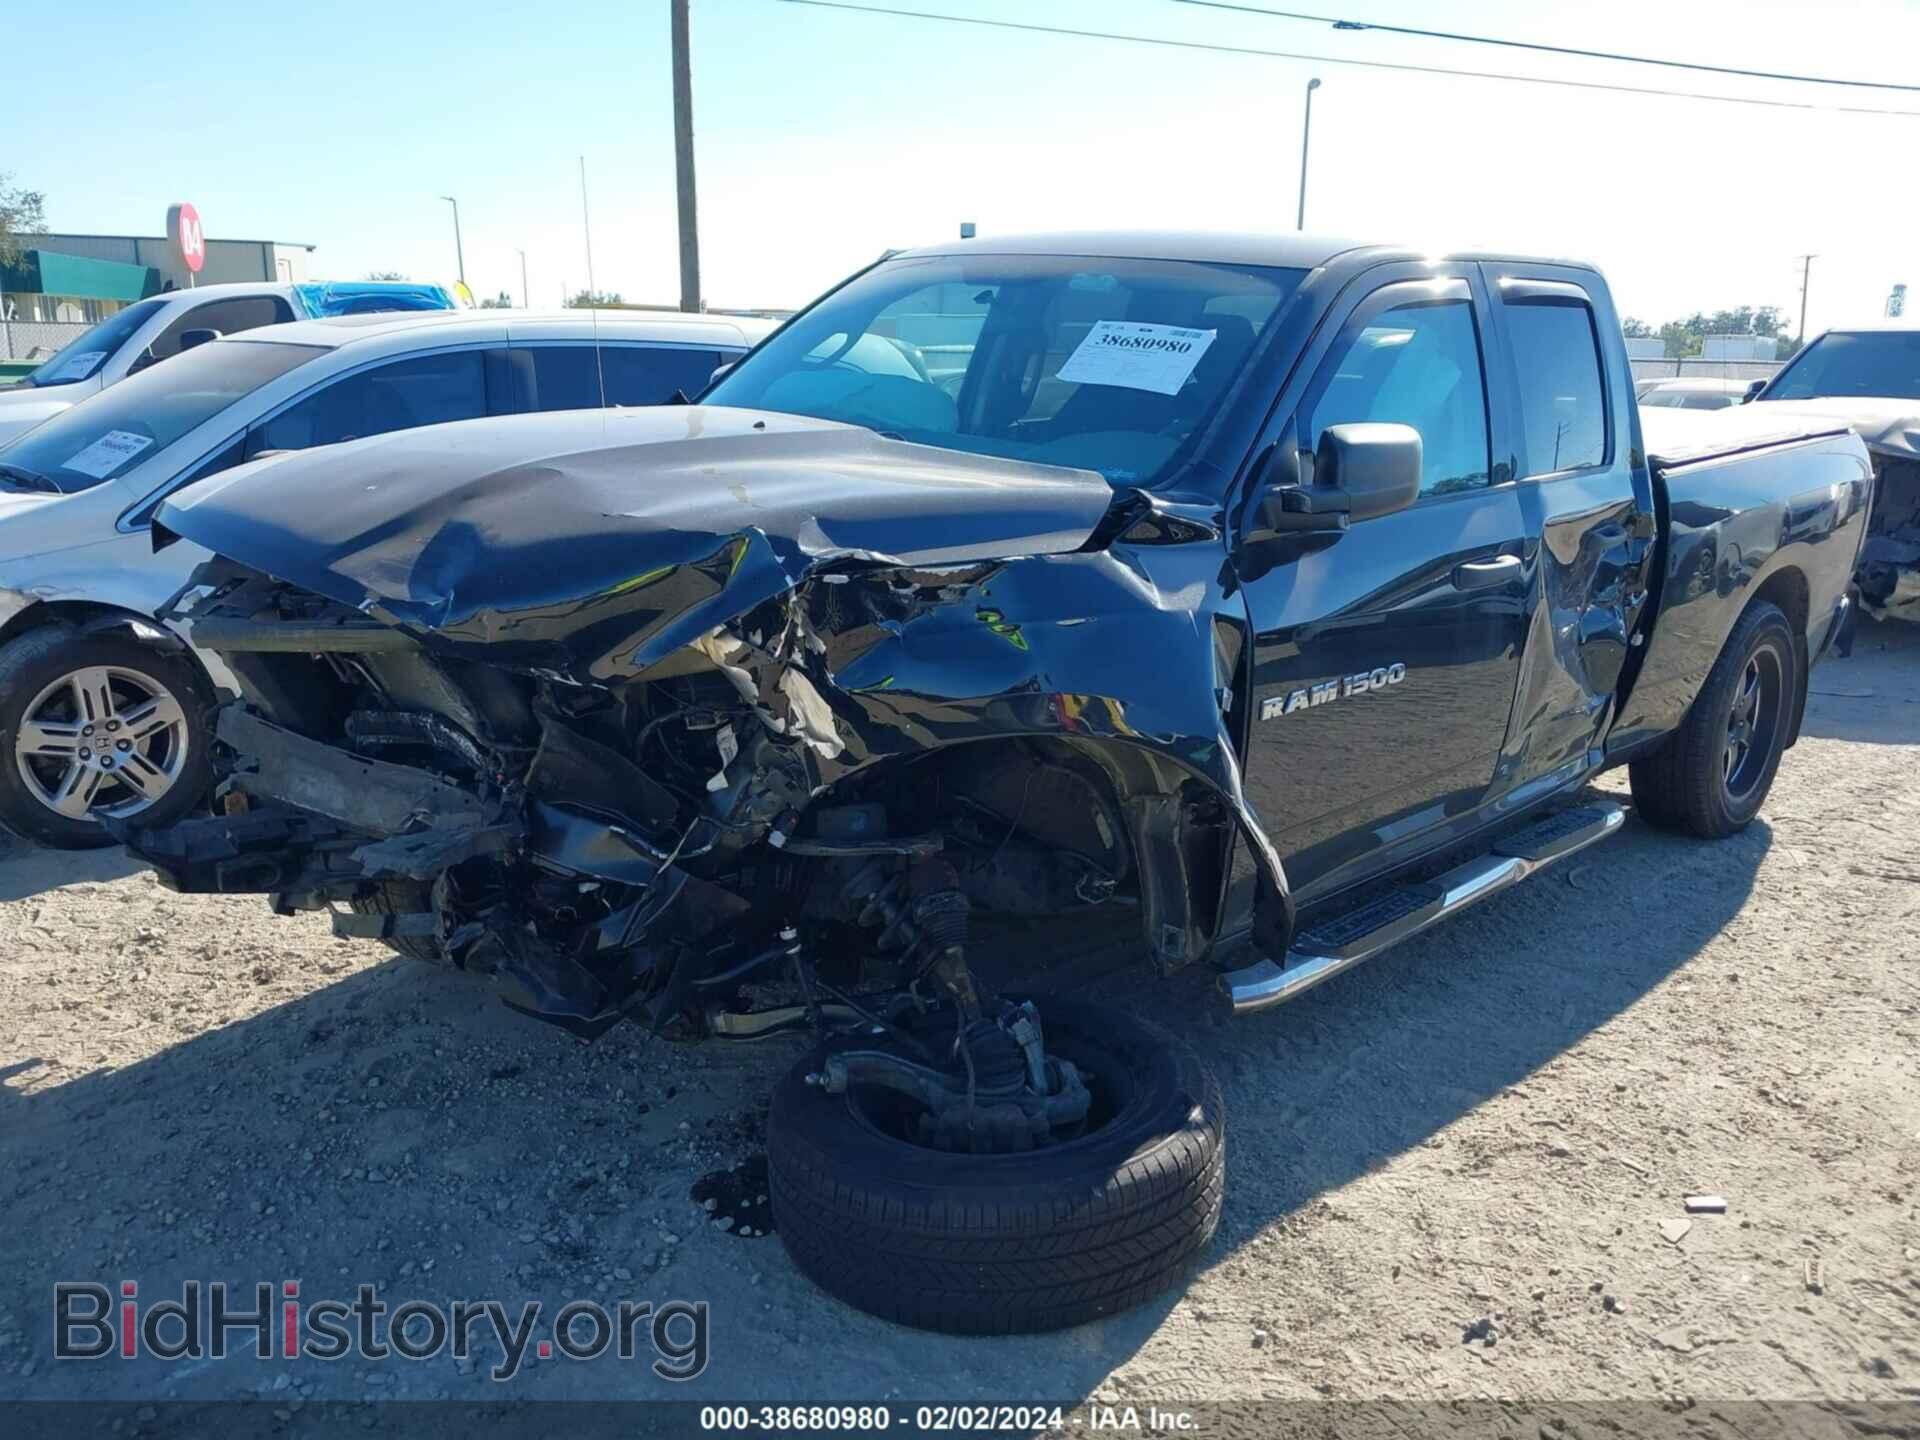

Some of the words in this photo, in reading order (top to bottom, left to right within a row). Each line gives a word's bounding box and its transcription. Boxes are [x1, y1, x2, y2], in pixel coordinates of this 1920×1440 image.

[1095, 333, 1192, 353] 38680980
[1260, 680, 1338, 721] RAM
[1342, 662, 1406, 697] 1500
